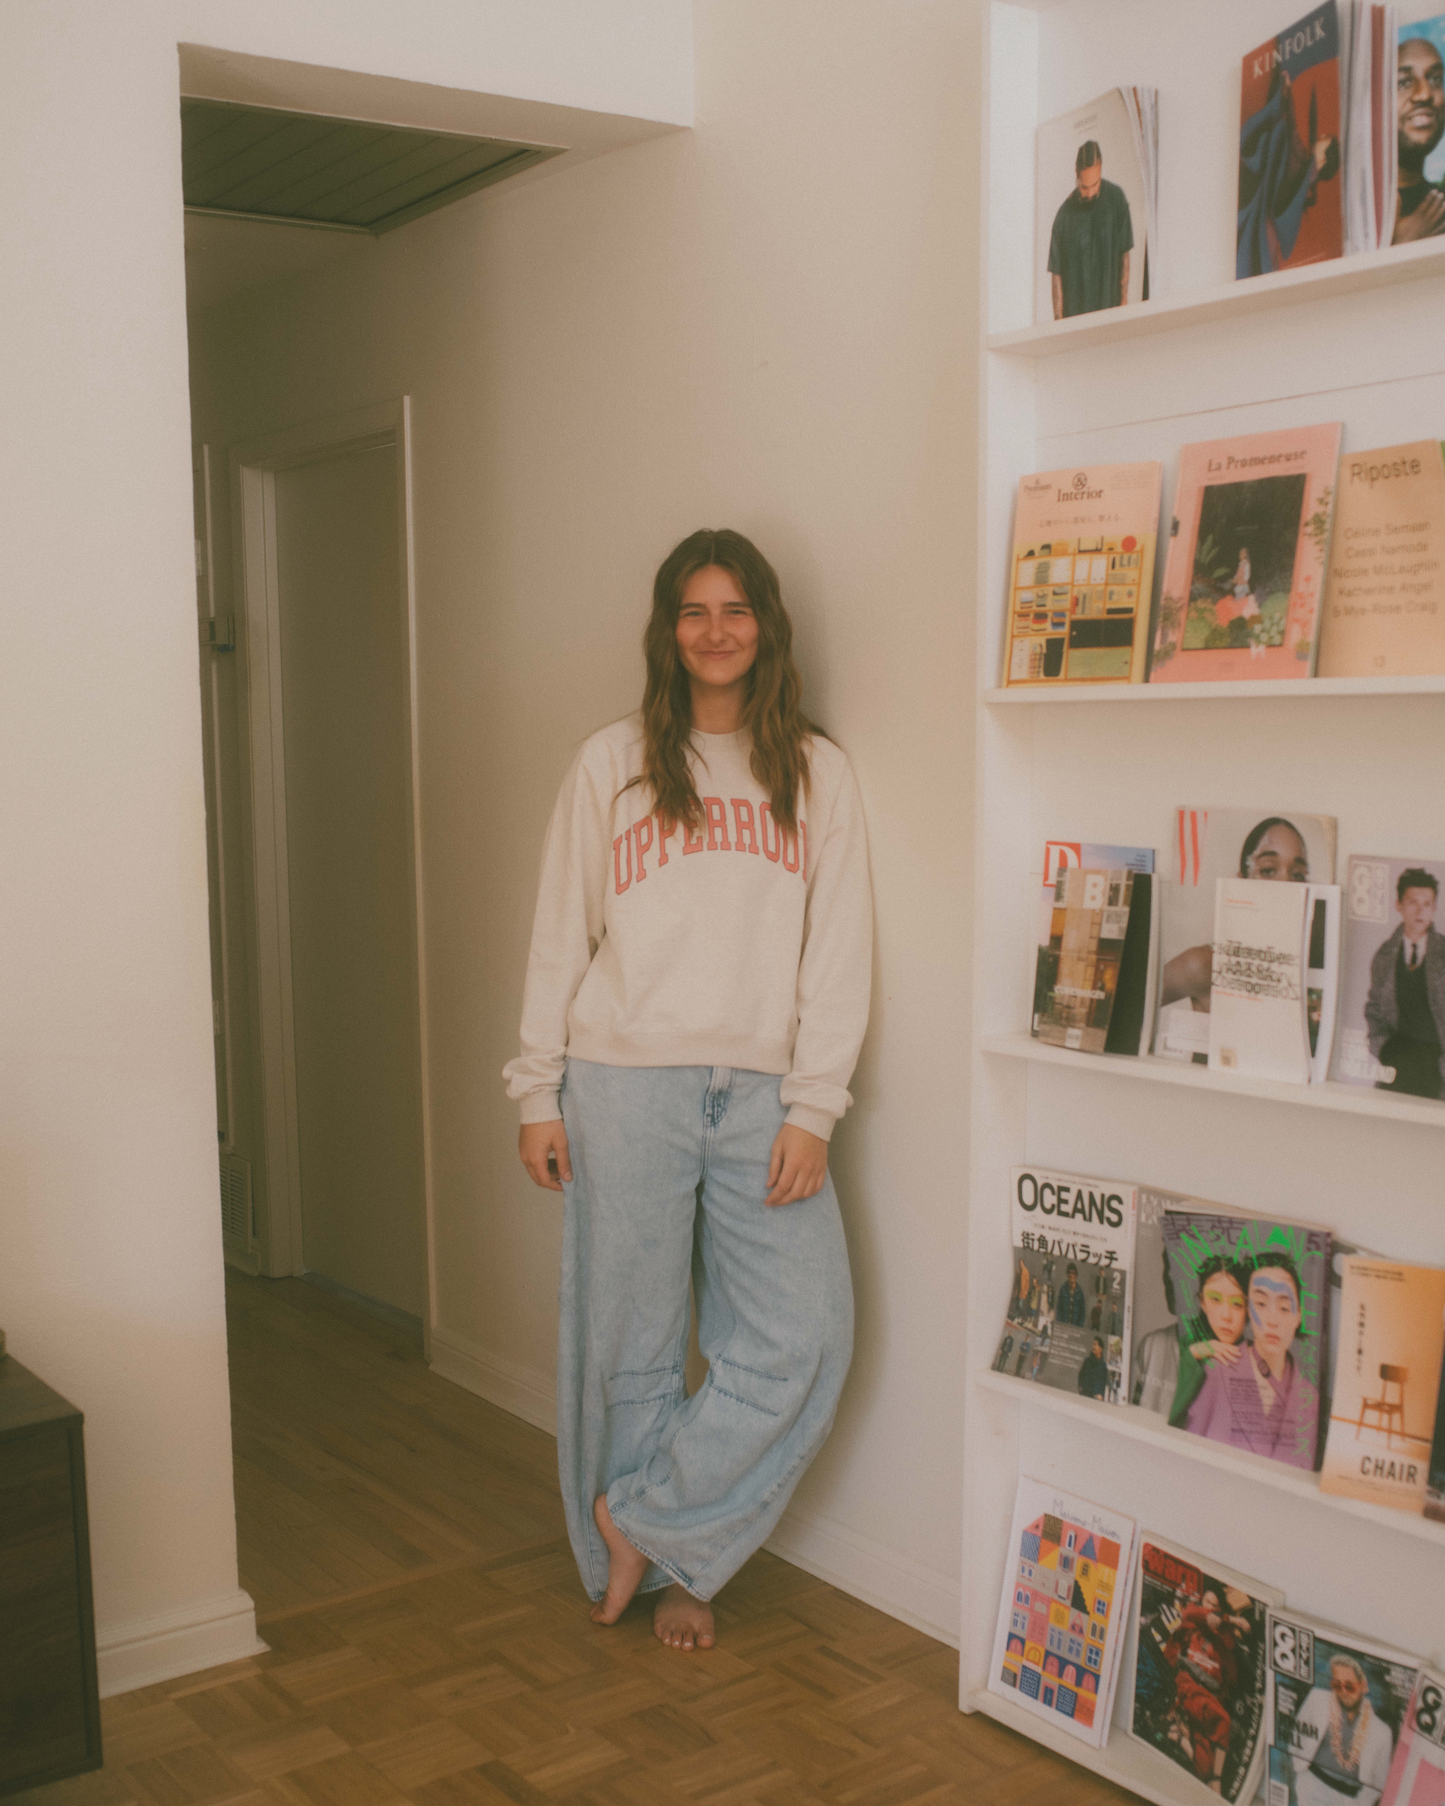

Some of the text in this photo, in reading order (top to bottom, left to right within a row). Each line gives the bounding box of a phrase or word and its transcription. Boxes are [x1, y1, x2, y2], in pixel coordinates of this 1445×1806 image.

[1253, 17, 1326, 79] KINFOLK
[1208, 449, 1308, 473] La Promeneuse
[1350, 457, 1421, 489] Riposte
[1057, 486, 1104, 502] Interior
[613, 797, 807, 895] UPPERROO
[1354, 866, 1371, 916] GQ
[1017, 1173, 1123, 1228] OCEANS
[1021, 1230, 1118, 1268] 街角パパラッチ
[1306, 1232, 1321, 1251] 5
[1112, 1271, 1122, 1290] 2
[1361, 1455, 1418, 1485] CHAIR
[1274, 1624, 1297, 1674] GQ
[1416, 1686, 1443, 1736] GQ
